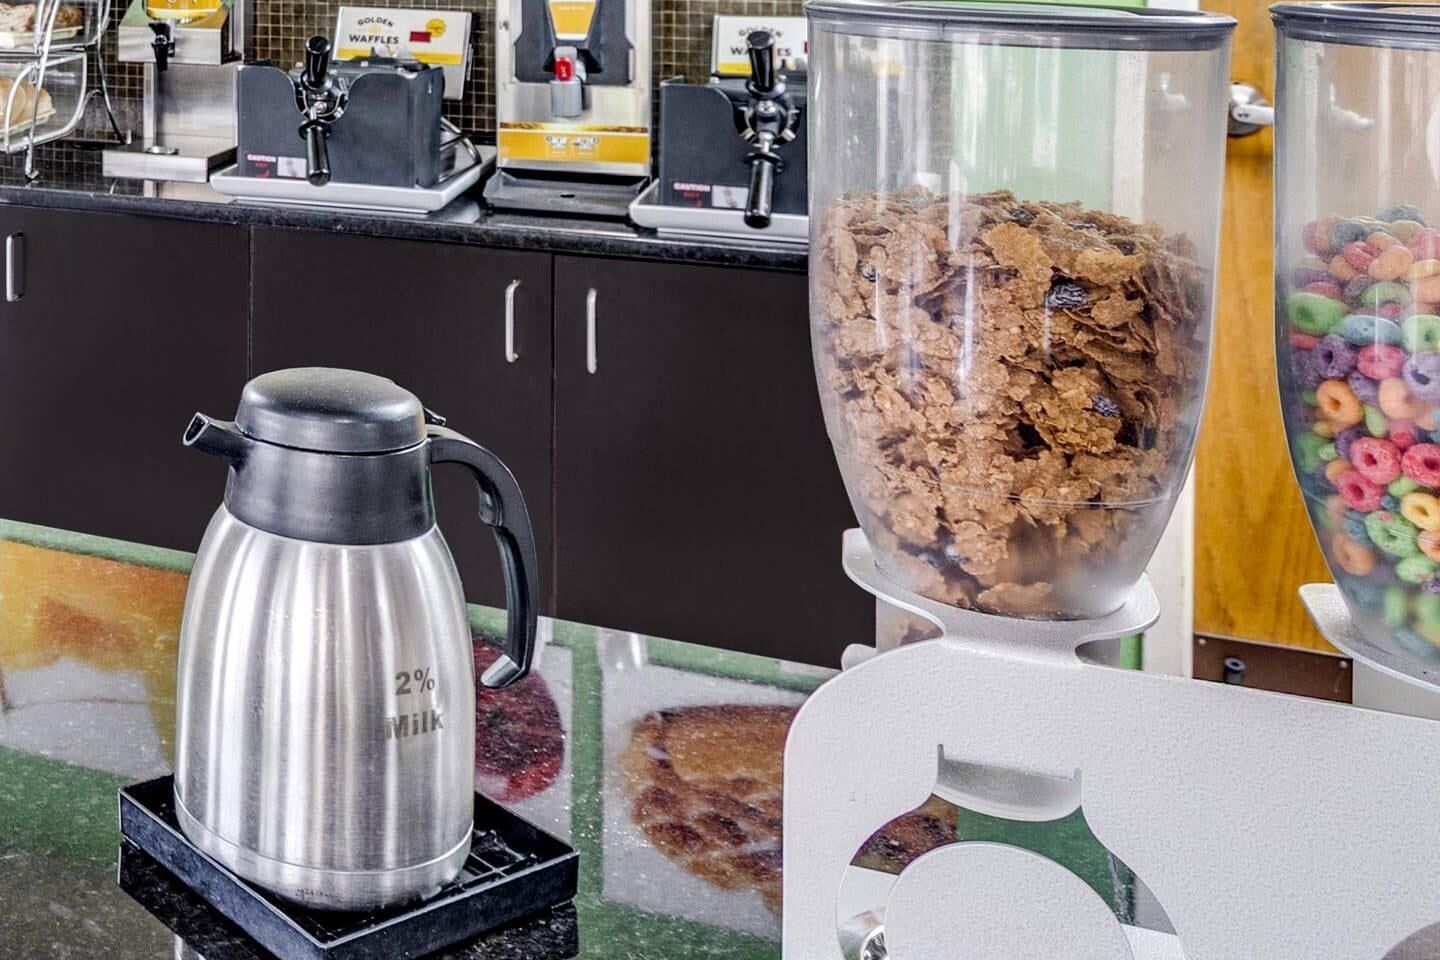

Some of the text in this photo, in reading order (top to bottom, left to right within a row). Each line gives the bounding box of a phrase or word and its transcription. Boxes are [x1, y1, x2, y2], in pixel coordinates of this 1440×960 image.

[357, 16, 395, 27] GOLDEN
[738, 26, 784, 37] GON
[348, 34, 400, 44] WAFFLES
[395, 667, 436, 696] 2%
[384, 709, 444, 739] Milk
